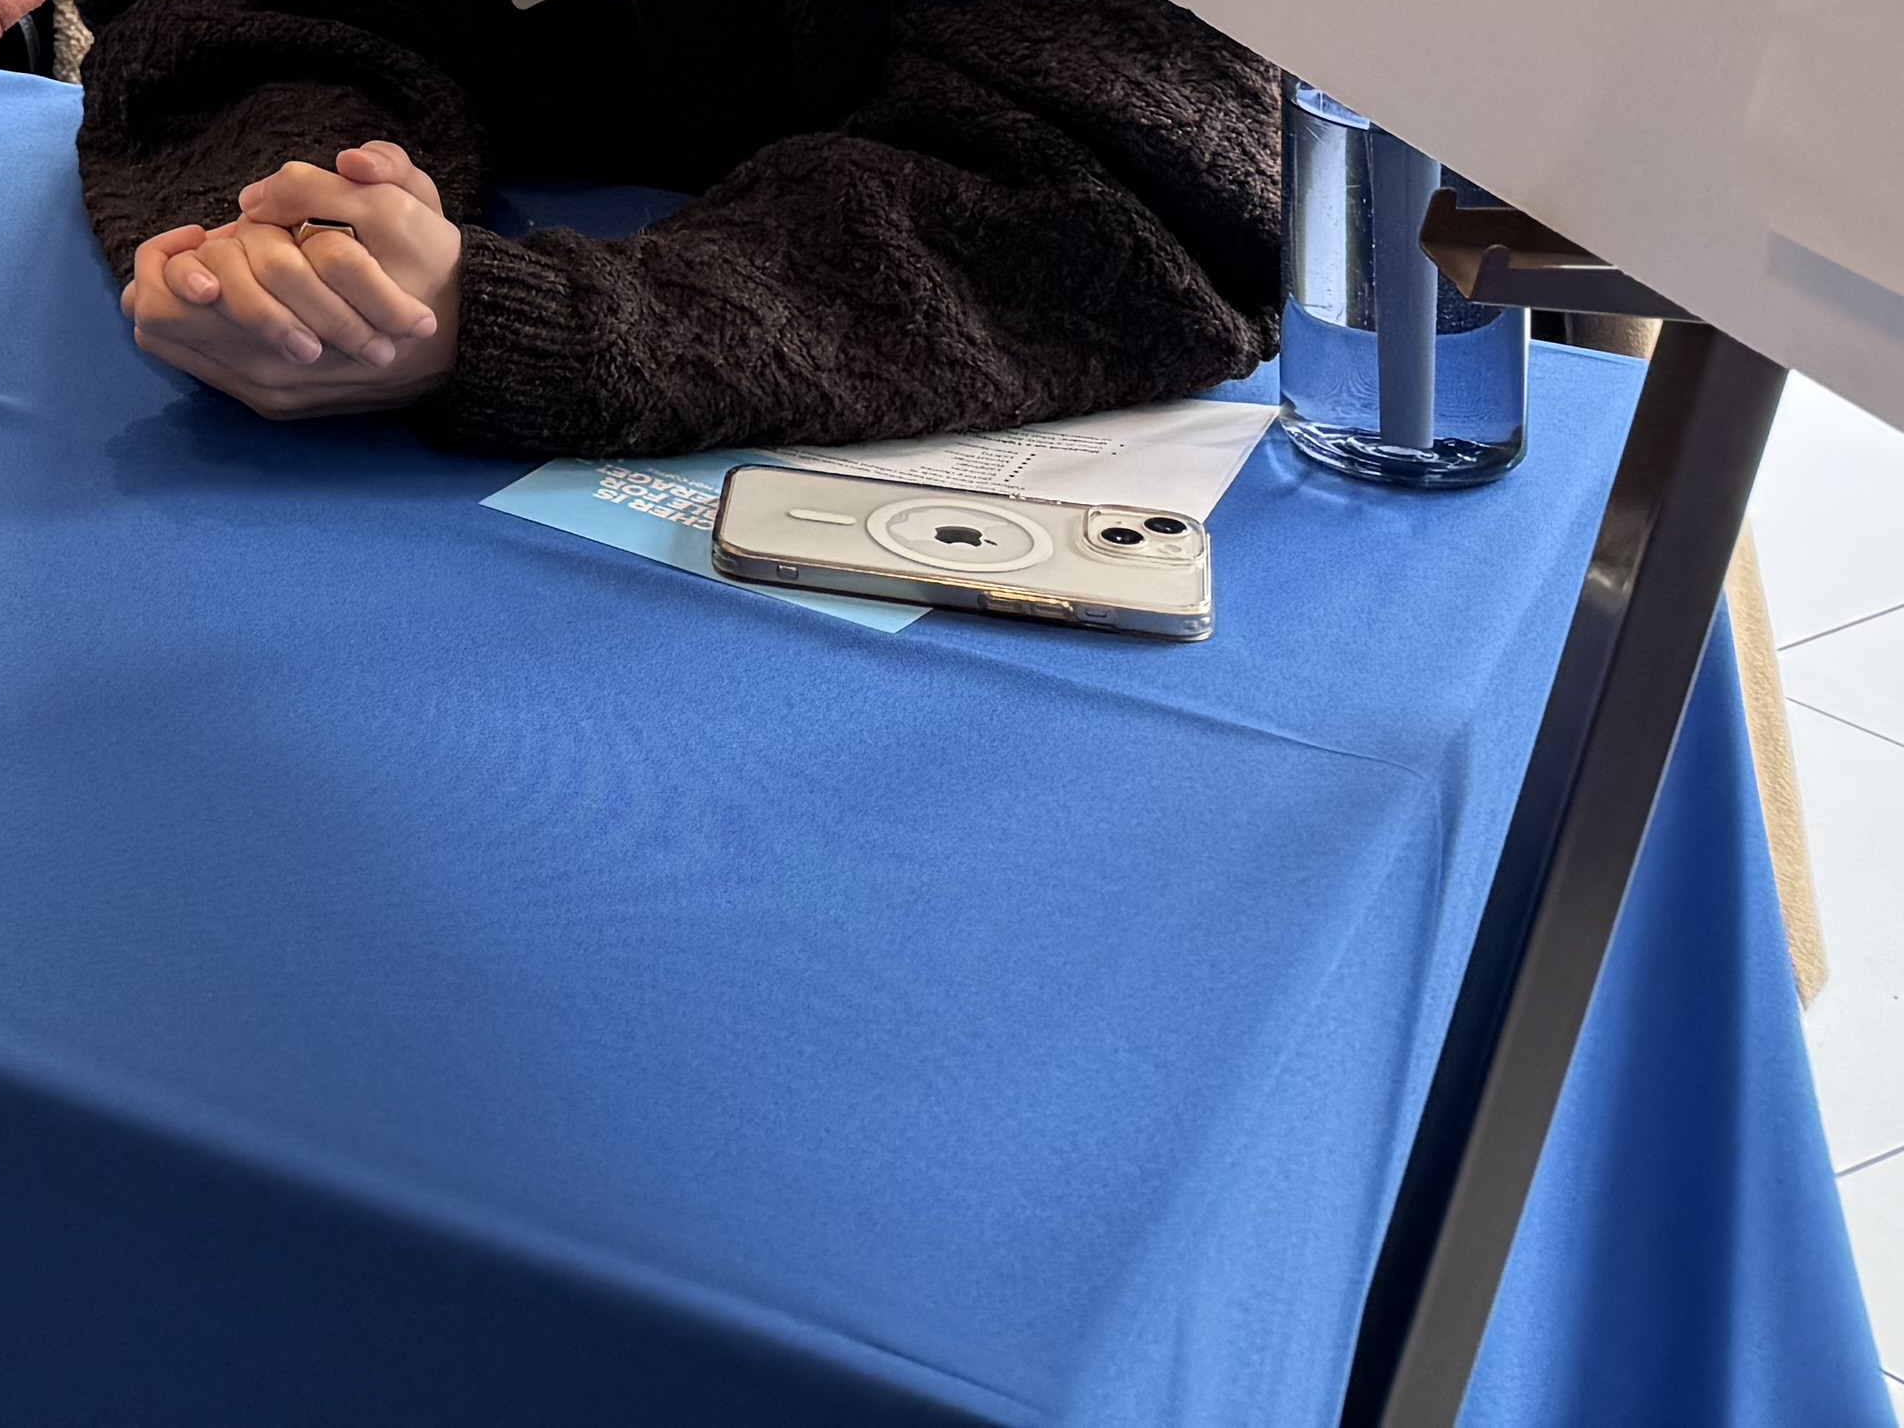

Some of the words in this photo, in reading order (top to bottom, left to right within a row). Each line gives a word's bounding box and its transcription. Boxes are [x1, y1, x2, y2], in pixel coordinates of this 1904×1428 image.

[593, 487, 630, 505] IS
[599, 476, 670, 503] FOR
[628, 498, 714, 531] CHER
